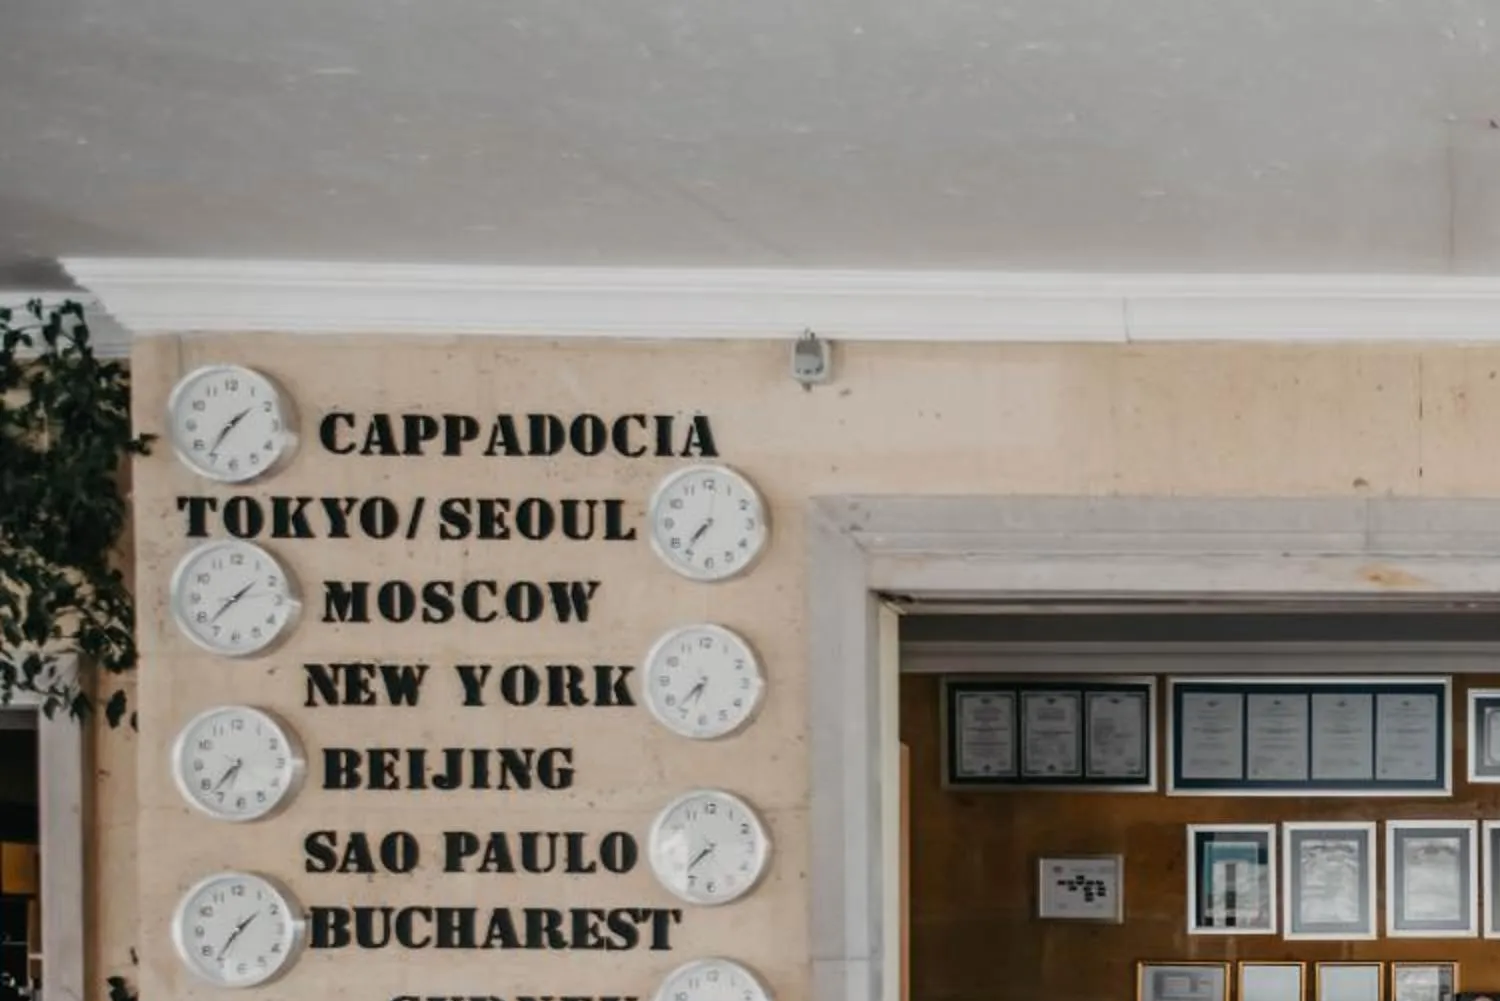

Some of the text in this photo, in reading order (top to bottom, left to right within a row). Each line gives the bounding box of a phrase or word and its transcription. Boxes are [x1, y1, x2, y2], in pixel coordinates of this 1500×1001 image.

[319, 412, 719, 458] CAPPADOCIA
[177, 496, 637, 540] TOKYO/SEOUL
[322, 580, 601, 624] MOSCOW
[304, 663, 636, 707] NEW YORK
[322, 748, 575, 790] BEIJING
[304, 831, 638, 874] SAO PAULO
[308, 906, 682, 950] BUCHAREST
